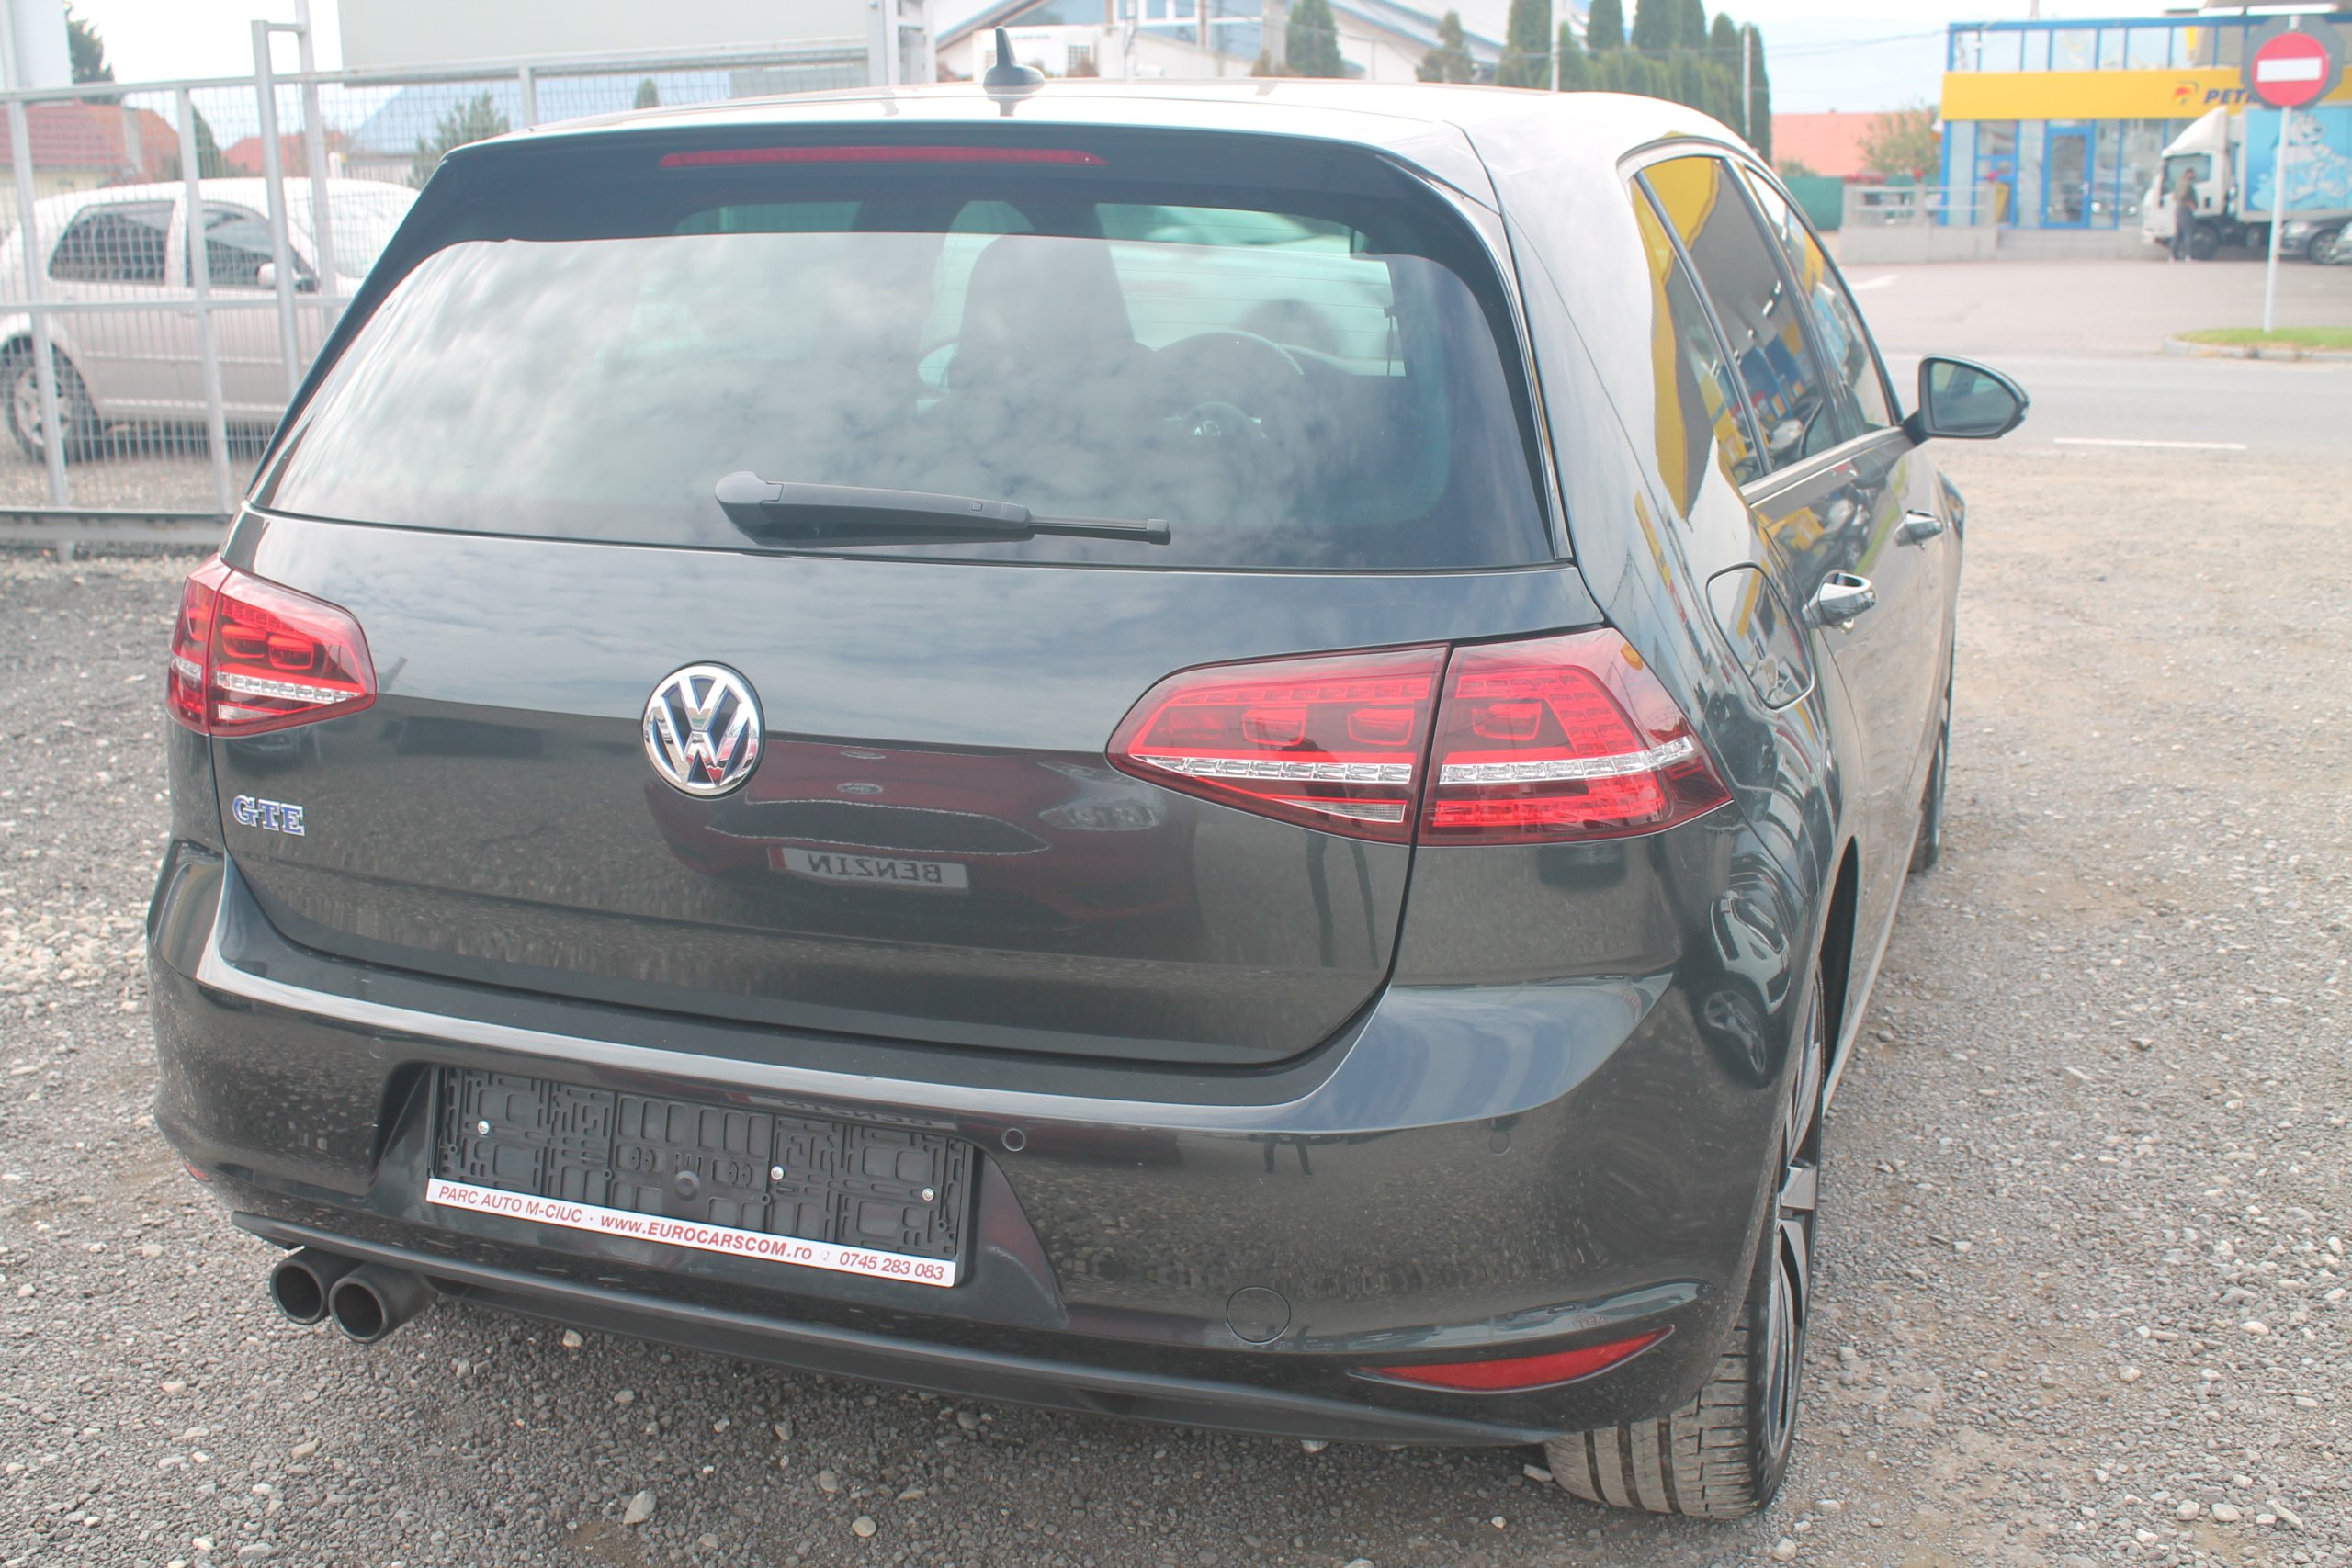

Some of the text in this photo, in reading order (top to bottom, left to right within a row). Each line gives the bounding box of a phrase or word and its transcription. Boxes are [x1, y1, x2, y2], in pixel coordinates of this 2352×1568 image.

[232, 795, 305, 837] GTE
[438, 1185, 944, 1280] PARC AUTO M-CIUC www.EUROCARSCOM.ro 0745 283 083
